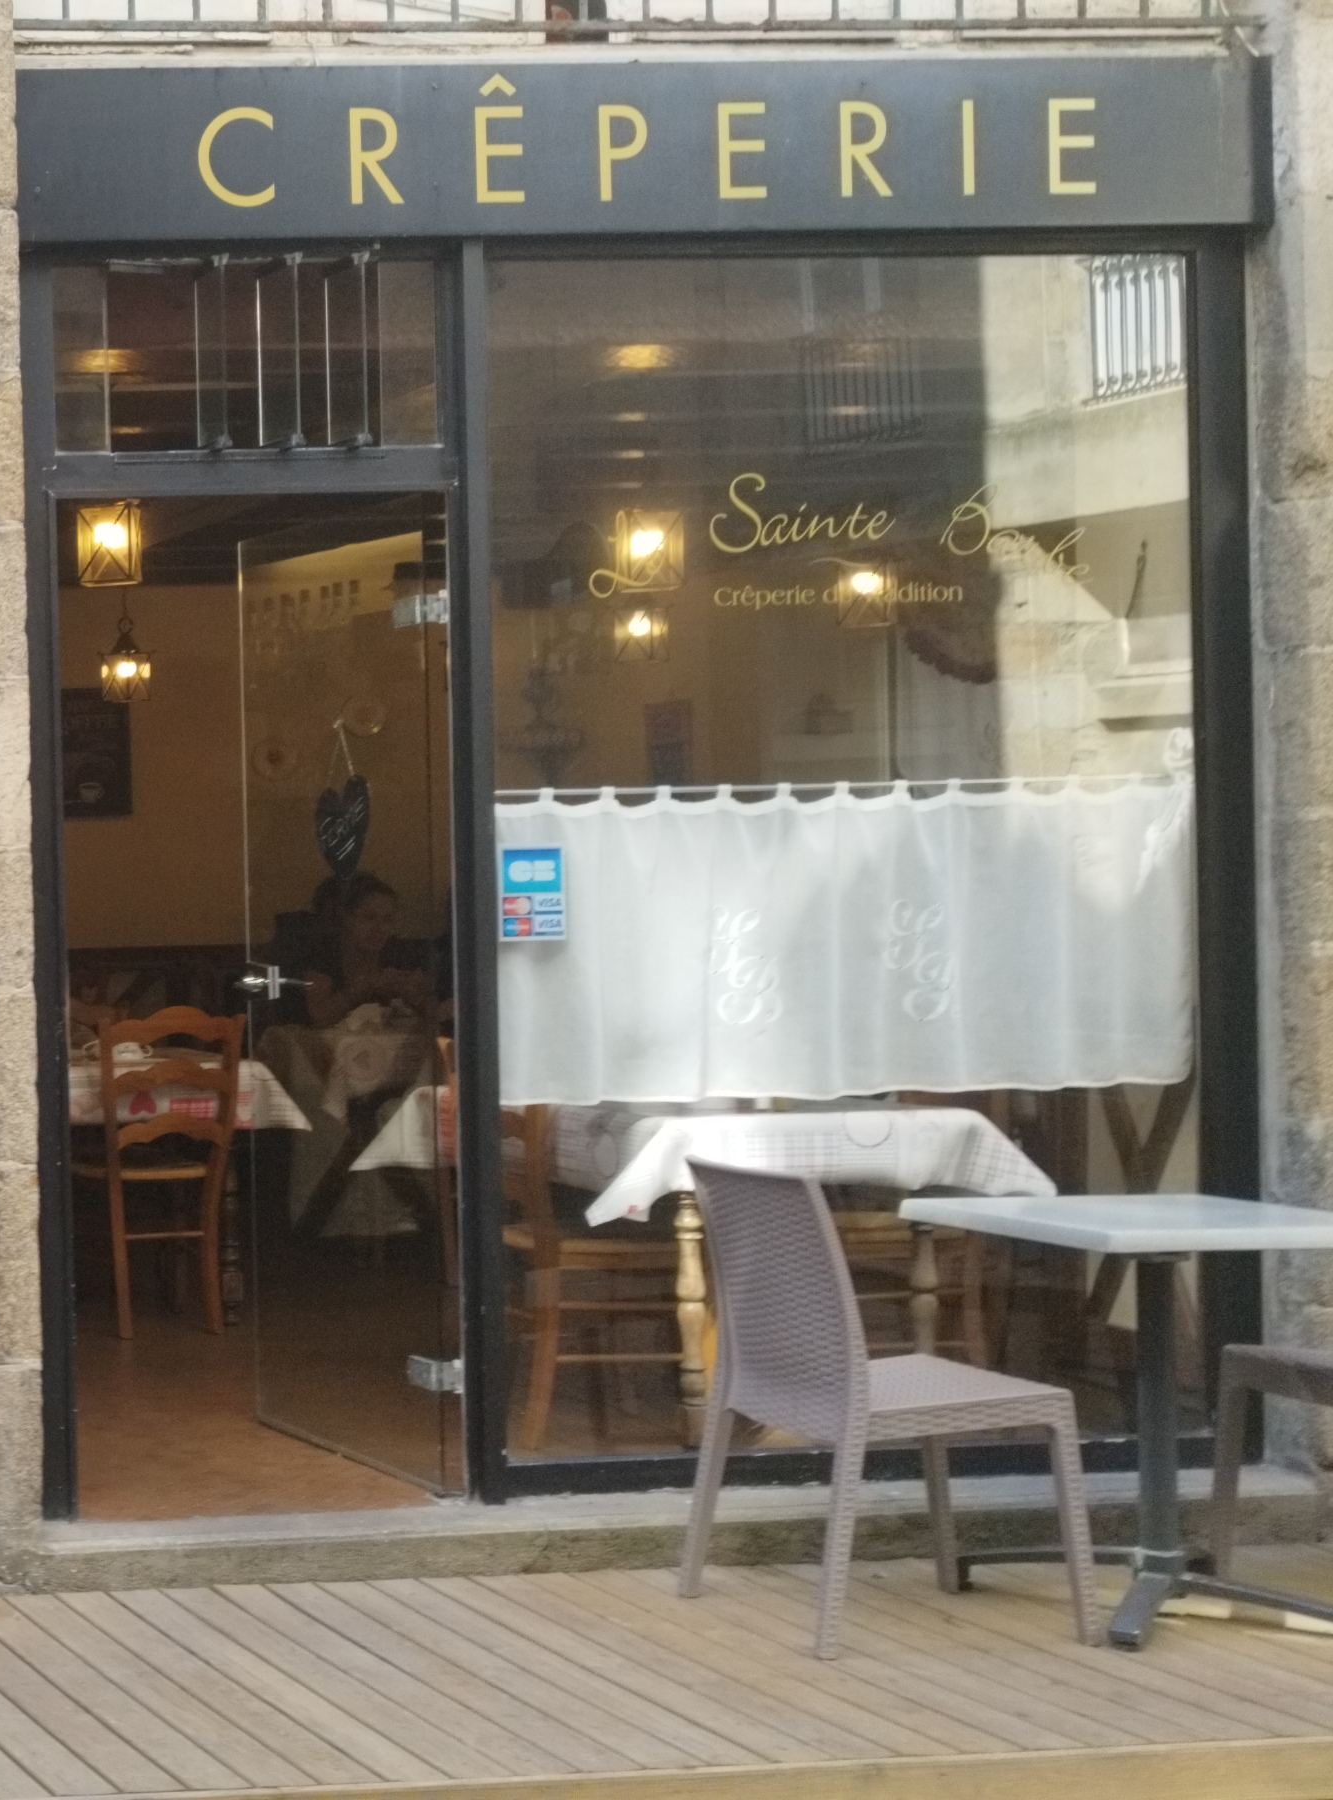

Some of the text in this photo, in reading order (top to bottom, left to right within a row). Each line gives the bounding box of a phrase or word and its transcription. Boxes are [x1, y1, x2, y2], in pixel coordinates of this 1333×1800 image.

[198, 73, 1098, 208] CRÊPERIE
[710, 473, 896, 553] Sainte
[713, 585, 815, 610] Crêperie
[858, 581, 963, 603] adition
[538, 898, 561, 908] VISA
[538, 919, 562, 929] VISA
